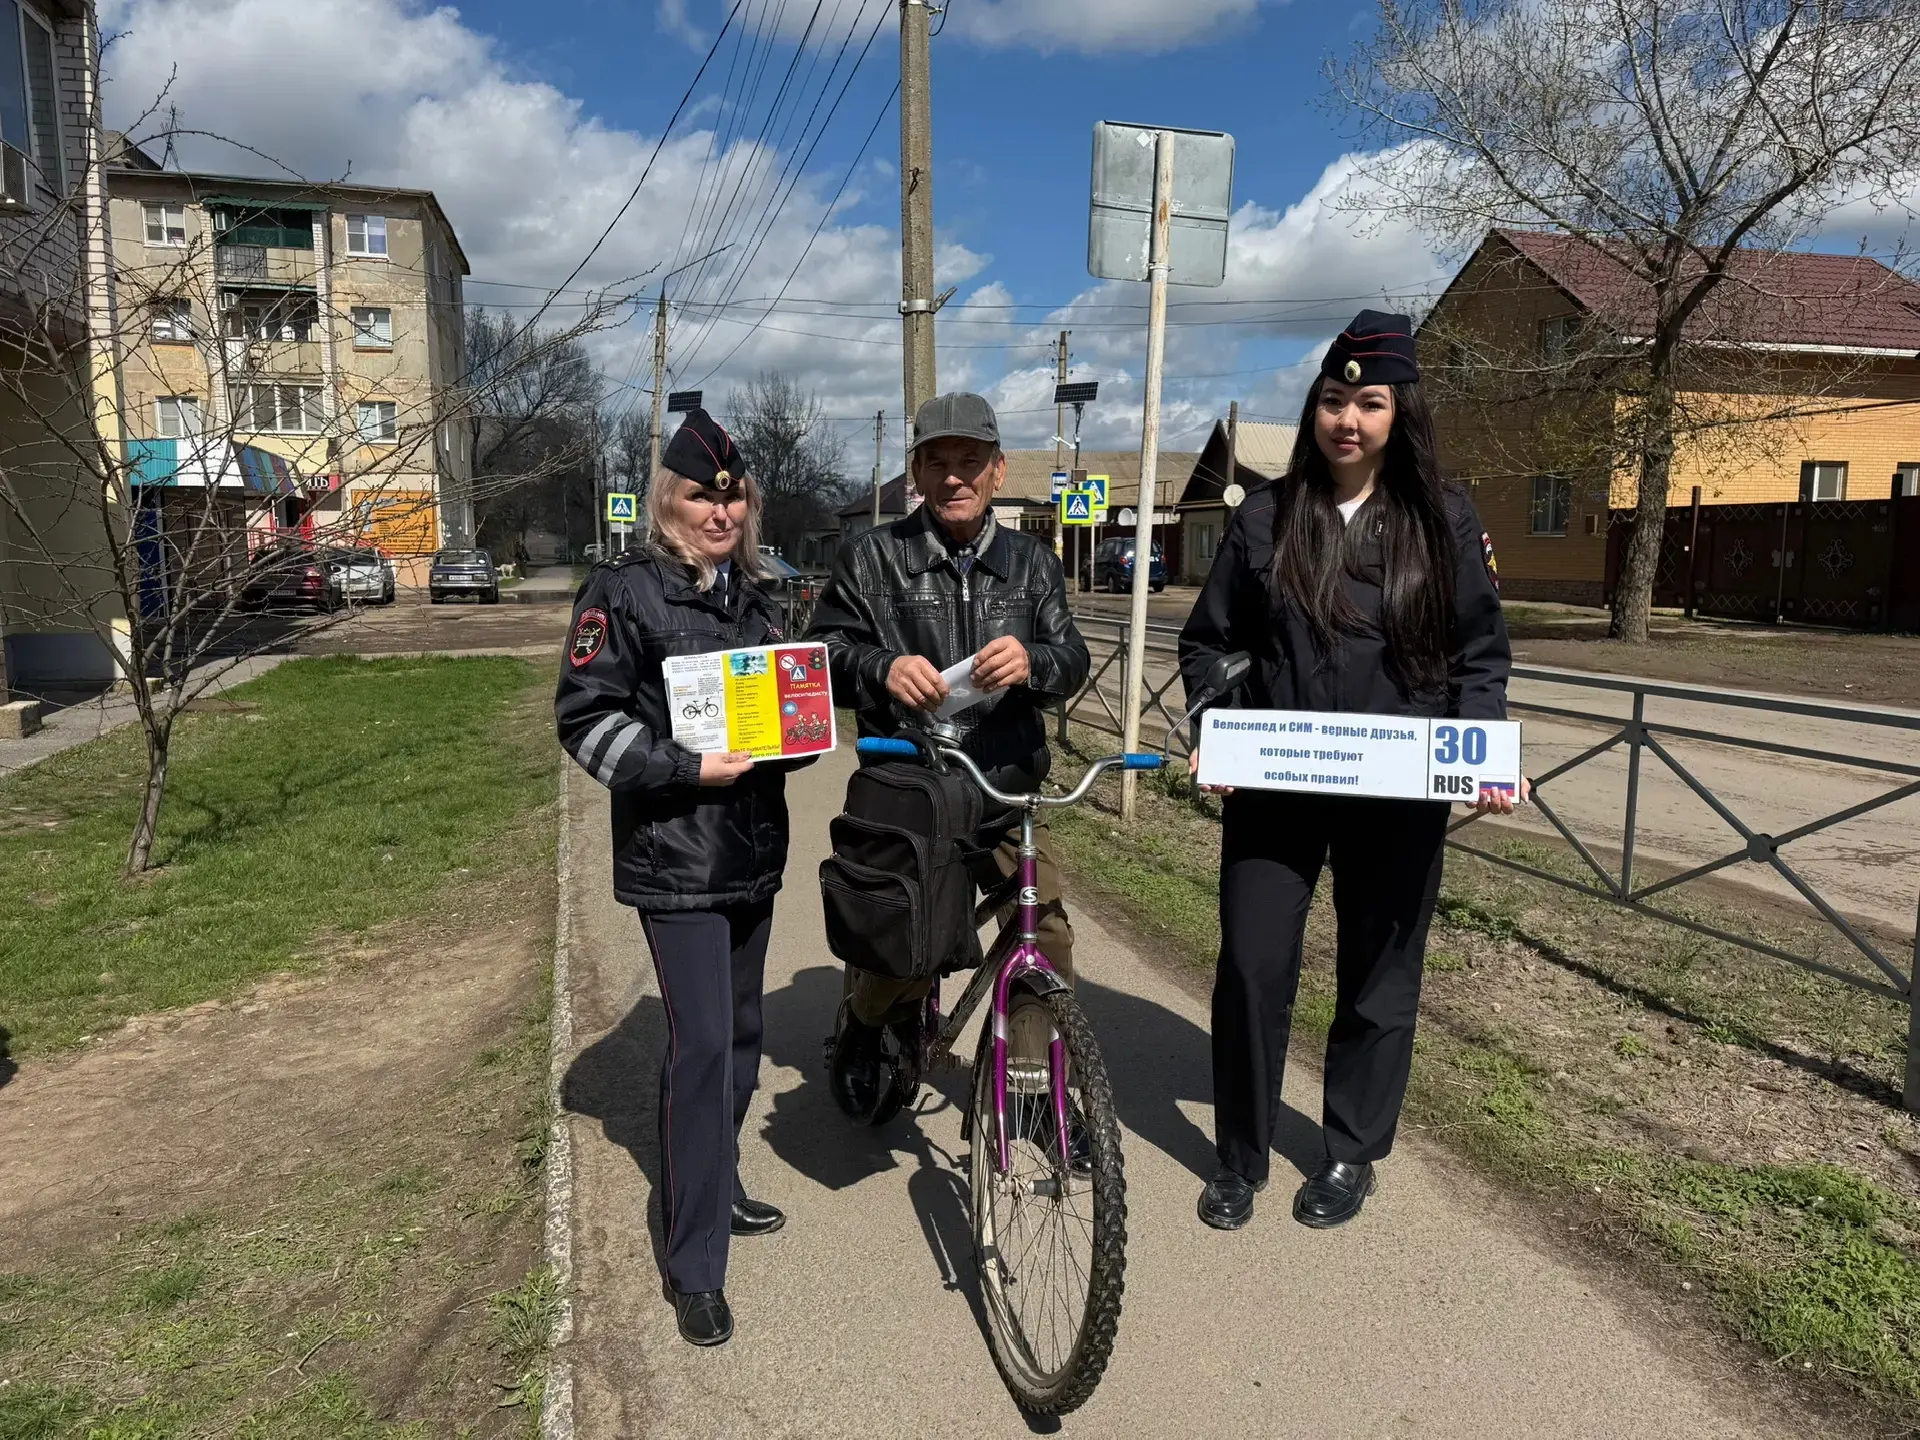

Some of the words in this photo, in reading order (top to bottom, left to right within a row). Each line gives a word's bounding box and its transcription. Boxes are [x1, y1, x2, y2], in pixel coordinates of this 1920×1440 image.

[790, 682, 821, 690] ПАМЯТКА
[1213, 719, 1276, 733] Велосипед
[1279, 723, 1286, 732] и
[1289, 722, 1312, 733] СИМ
[1322, 725, 1367, 737] верные
[1370, 728, 1417, 742] друзья,
[1260, 747, 1310, 760] которые
[1313, 750, 1363, 762] требуют
[1435, 726, 1487, 765] 30
[1264, 770, 1308, 782] особых
[1311, 774, 1358, 786] правил!
[1434, 775, 1473, 795] RUS
